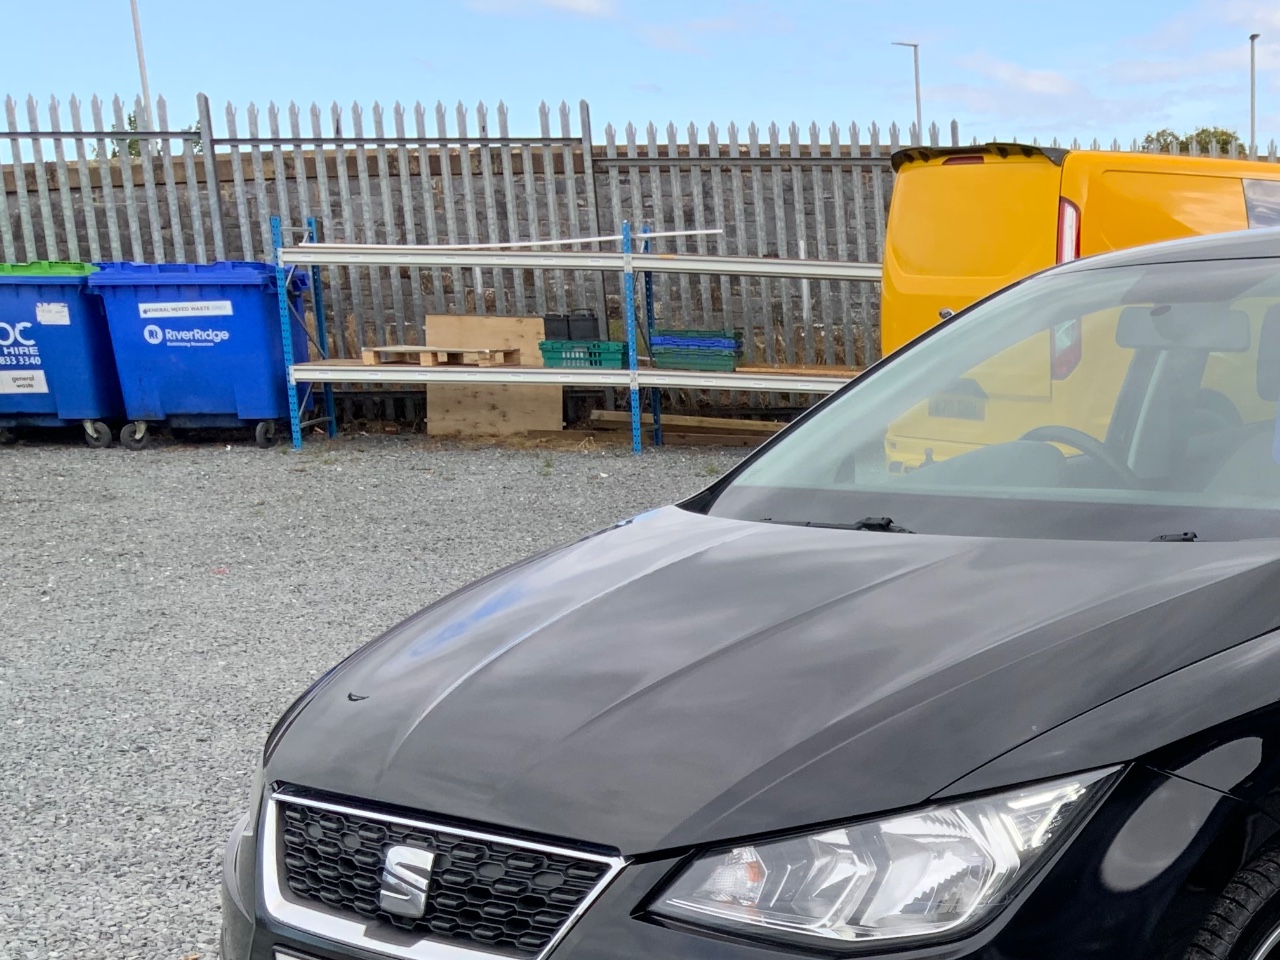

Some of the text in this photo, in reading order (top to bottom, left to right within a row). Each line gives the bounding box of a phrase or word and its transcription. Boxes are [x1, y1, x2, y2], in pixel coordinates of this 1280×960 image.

[165, 328, 229, 342] RiverRidge
[3, 346, 39, 355] HIRE
[18, 356, 42, 365] 3340
[12, 375, 34, 384] general
